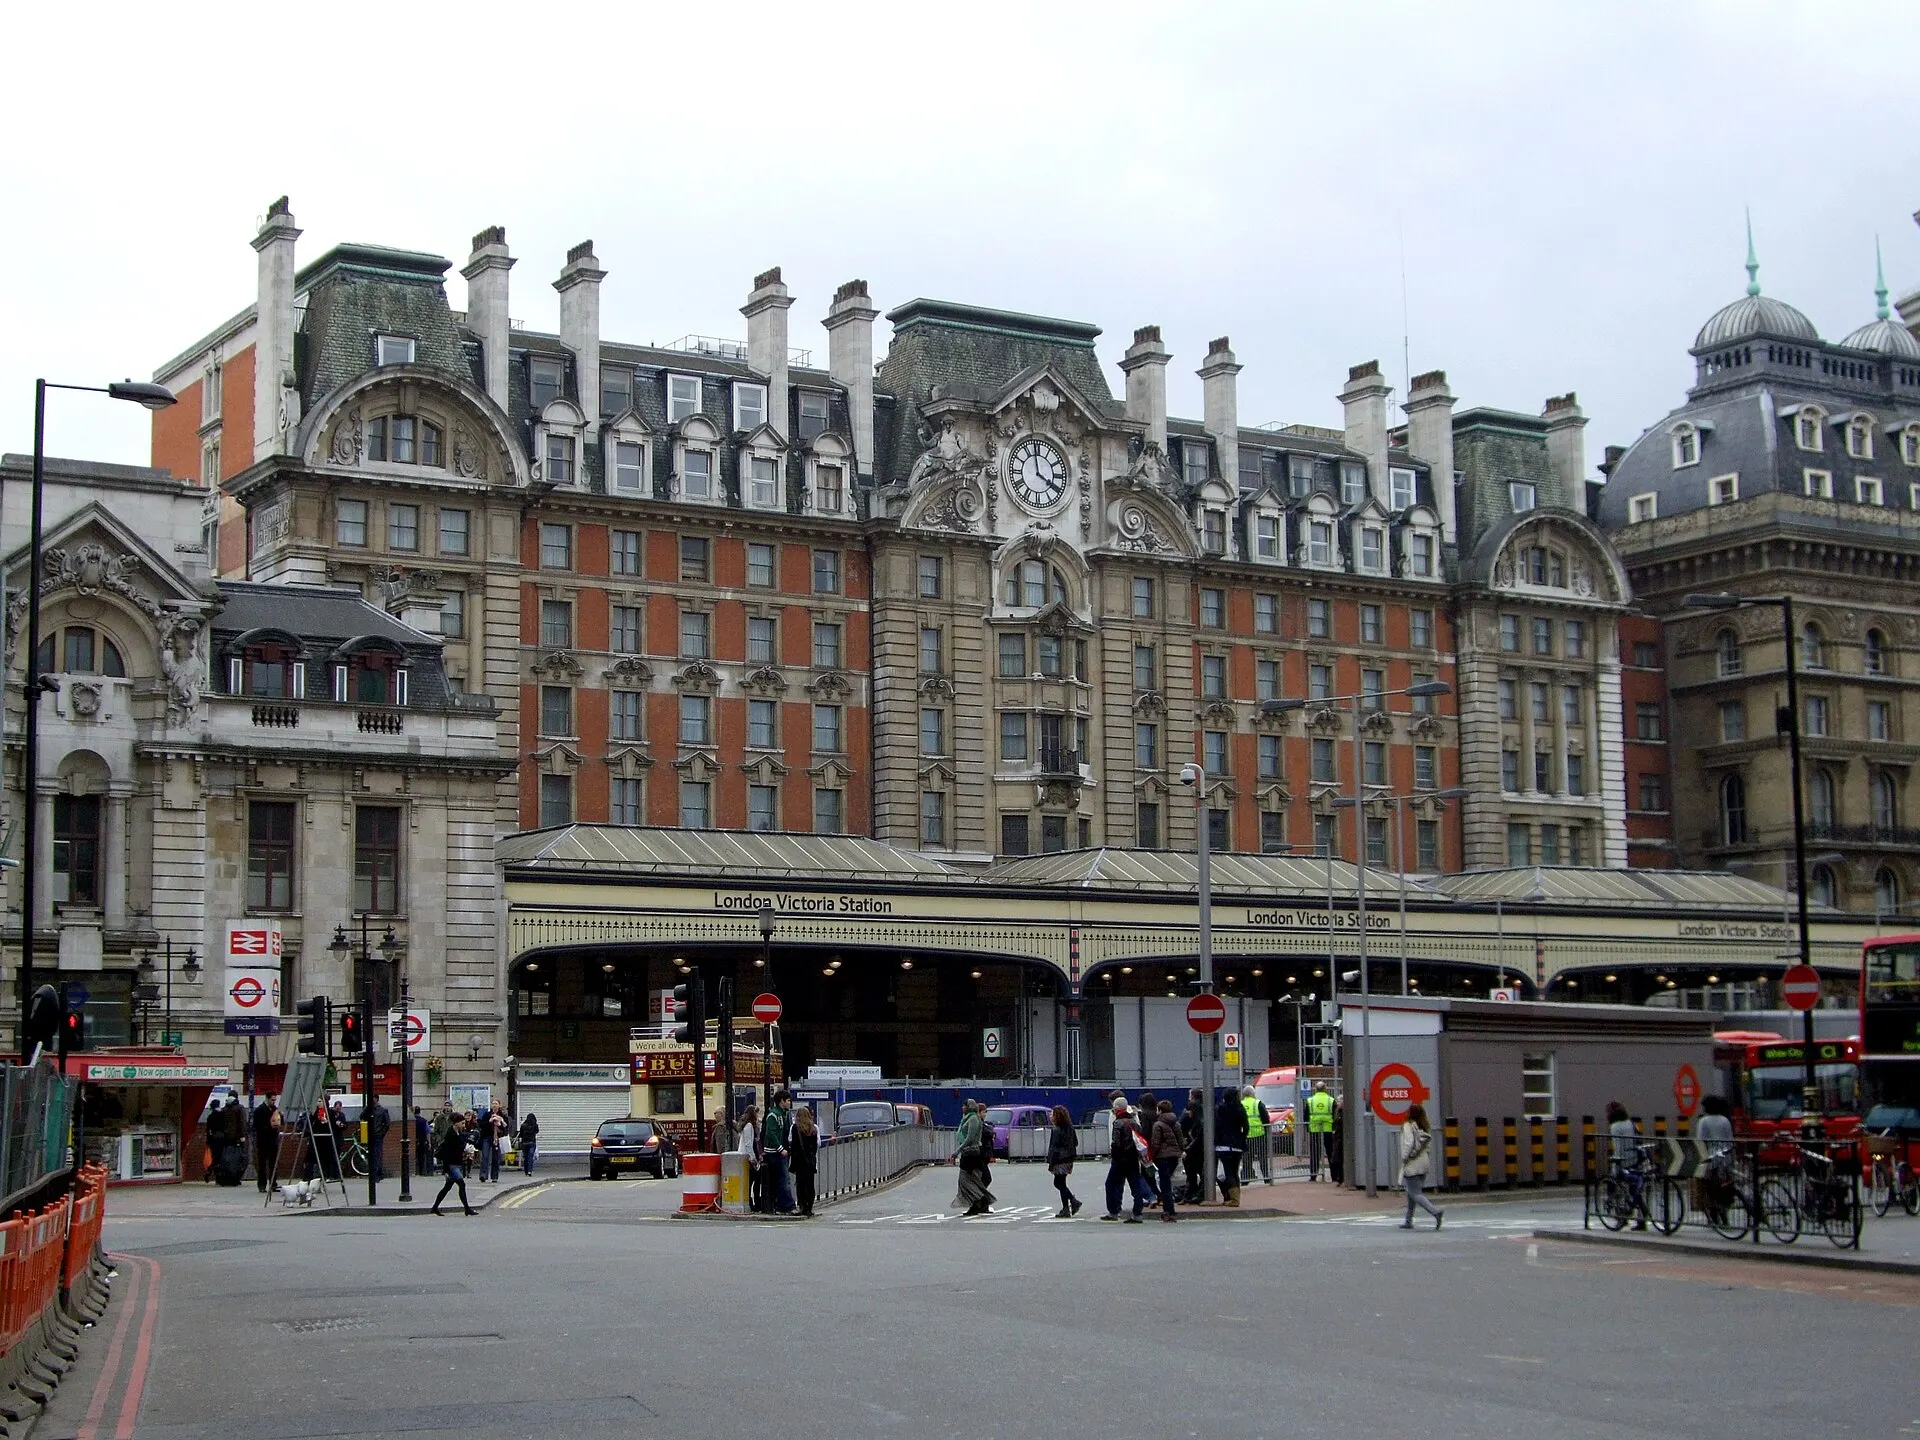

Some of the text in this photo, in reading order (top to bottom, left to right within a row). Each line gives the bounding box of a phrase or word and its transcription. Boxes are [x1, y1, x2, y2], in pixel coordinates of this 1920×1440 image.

[714, 892, 891, 912] London Victoria Station
[1247, 909, 1293, 925] London
[1348, 912, 1390, 927] Sttion
[1679, 923, 1716, 936] London
[1719, 924, 1757, 937] Victoria
[635, 1041, 656, 1050] We're
[658, 1041, 667, 1050] all
[138, 1068, 153, 1076] Now
[155, 1068, 171, 1078] open
[174, 1067, 180, 1076] in
[182, 1067, 209, 1077] Cardinal
[211, 1067, 228, 1077] Place
[1383, 1090, 1409, 1098] BUSES
